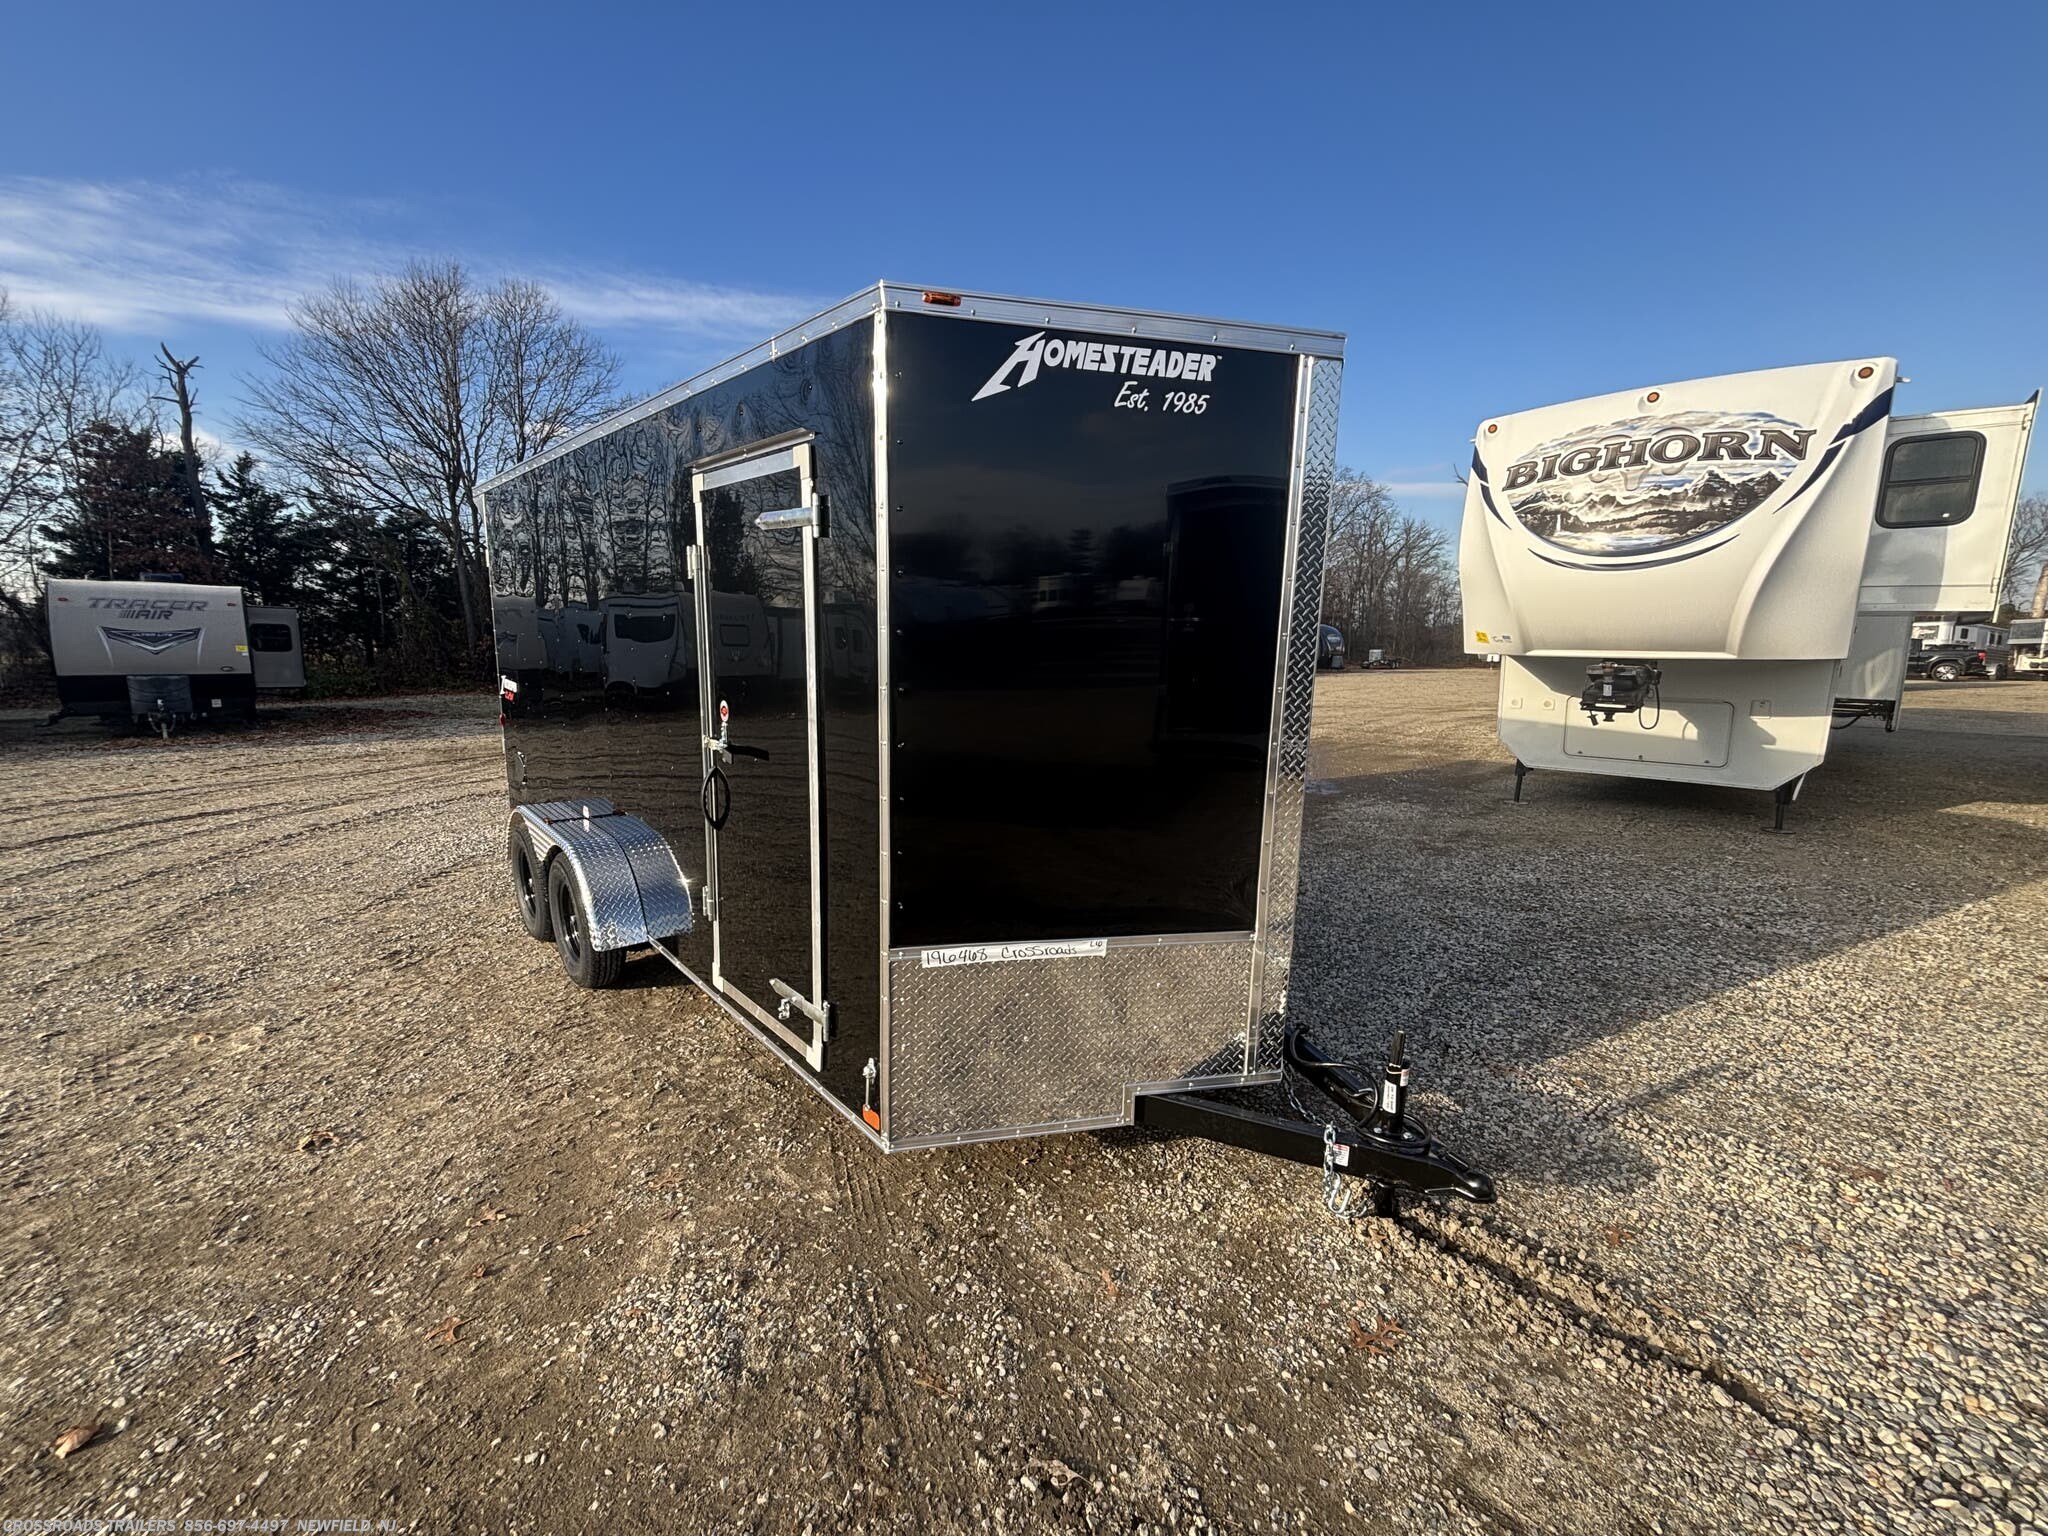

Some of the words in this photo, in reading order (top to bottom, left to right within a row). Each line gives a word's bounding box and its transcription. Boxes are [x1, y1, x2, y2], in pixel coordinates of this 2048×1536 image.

[972, 331, 1217, 401] HOMESTEADER
[1114, 381, 1149, 412] Est.
[1161, 391, 1211, 415] 1985
[1502, 429, 1817, 492] BIGHORN
[88, 598, 208, 611] TRACER
[135, 609, 174, 620] AIR
[925, 949, 989, 966] 196468
